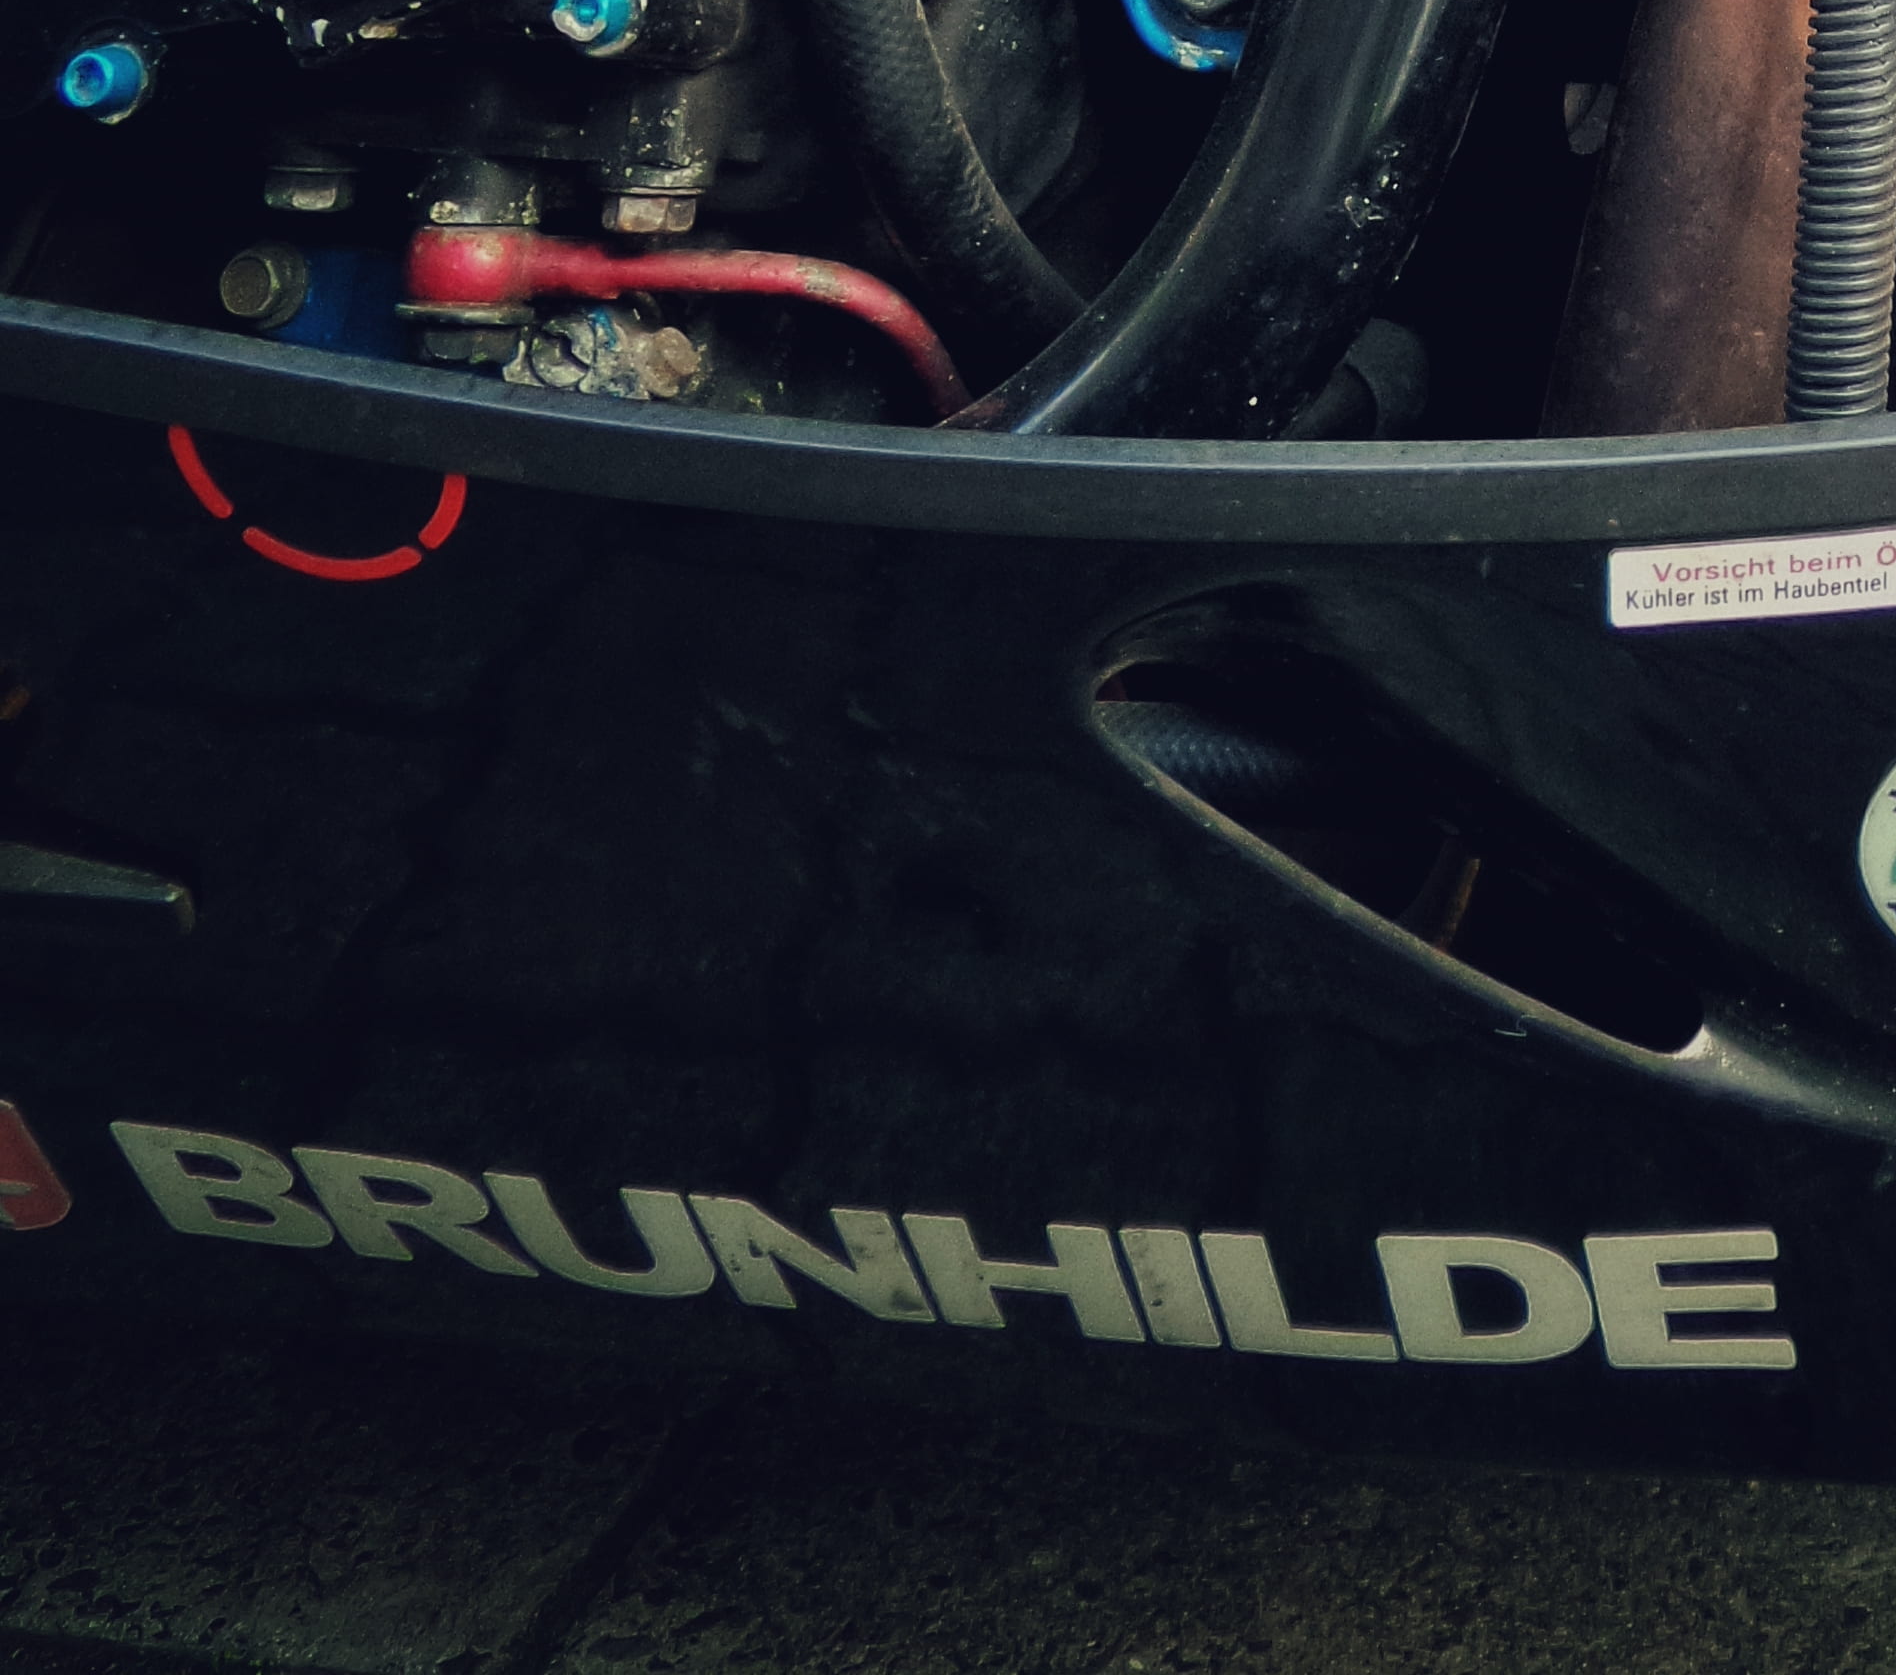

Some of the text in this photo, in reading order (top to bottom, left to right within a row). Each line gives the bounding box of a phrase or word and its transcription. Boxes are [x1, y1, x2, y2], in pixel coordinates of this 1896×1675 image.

[1653, 557, 1776, 583] Vorsicht
[1789, 550, 1861, 575] beim
[1626, 588, 1694, 611] Kühler
[1704, 585, 1729, 606] ist
[1738, 583, 1764, 603] im
[109, 1119, 1798, 1369] BRUNHILDE
